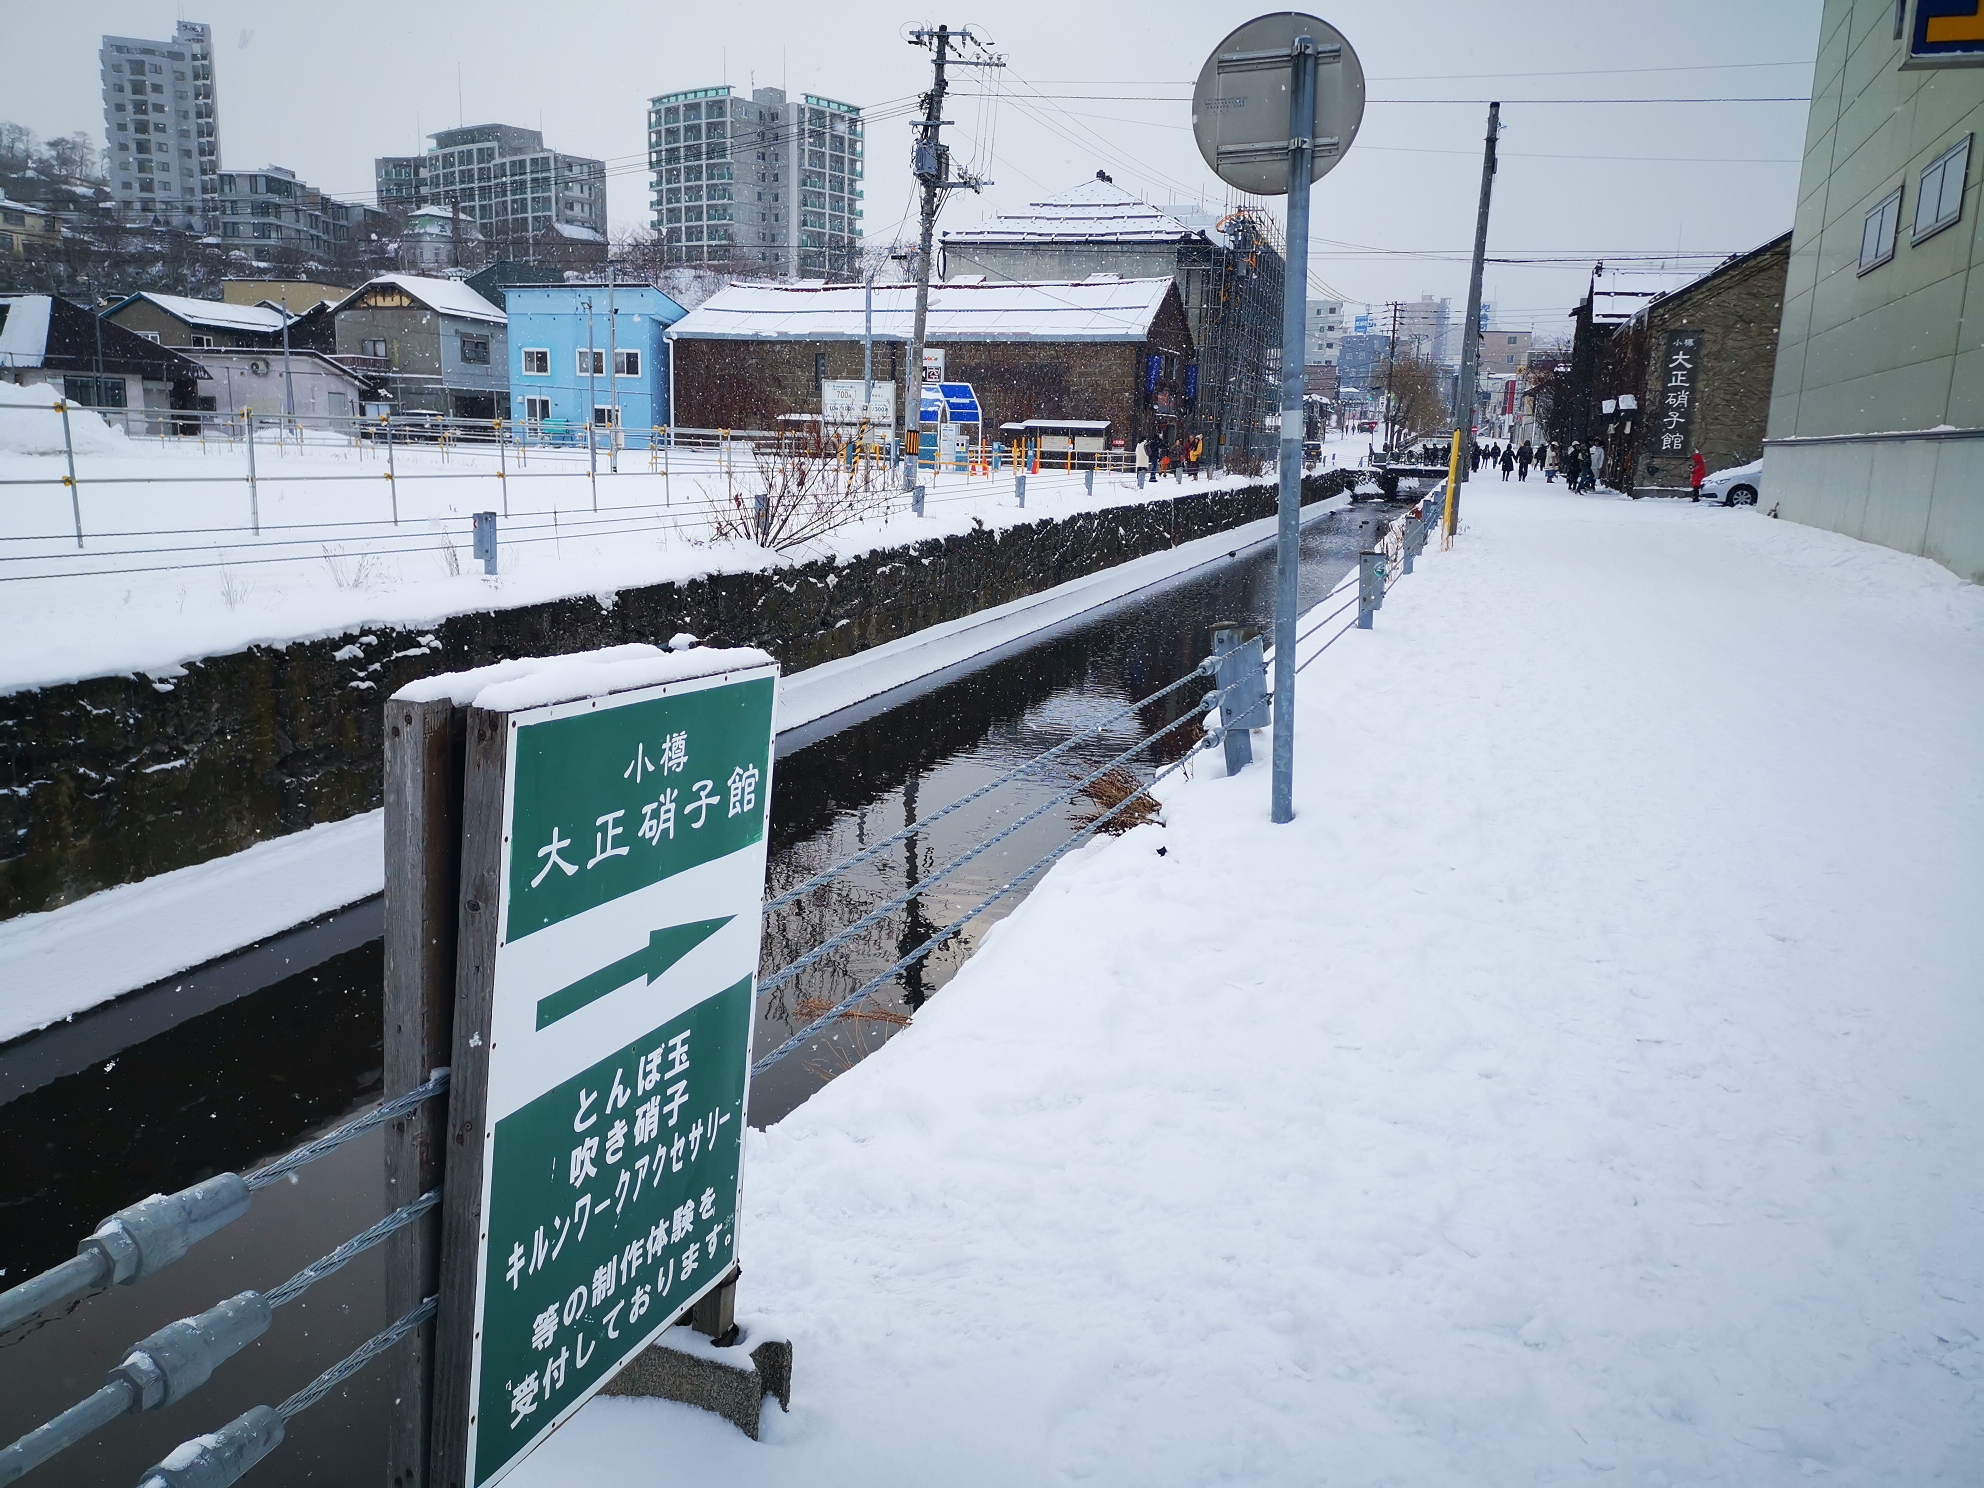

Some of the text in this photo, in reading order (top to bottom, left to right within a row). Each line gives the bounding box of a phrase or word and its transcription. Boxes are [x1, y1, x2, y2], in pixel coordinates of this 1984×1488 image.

[1661, 350, 1693, 450] 大正硝子館
[623, 730, 689, 784] 小樽
[530, 763, 758, 888] 大正硝子館
[569, 1079, 689, 1189] 吹き硝子
[573, 1029, 691, 1133] とんぼ玉
[505, 1107, 731, 1291] キルンワークアクセサリー
[509, 1222, 731, 1430] 受付しております。
[531, 1186, 717, 1351] 等の制作体験を
